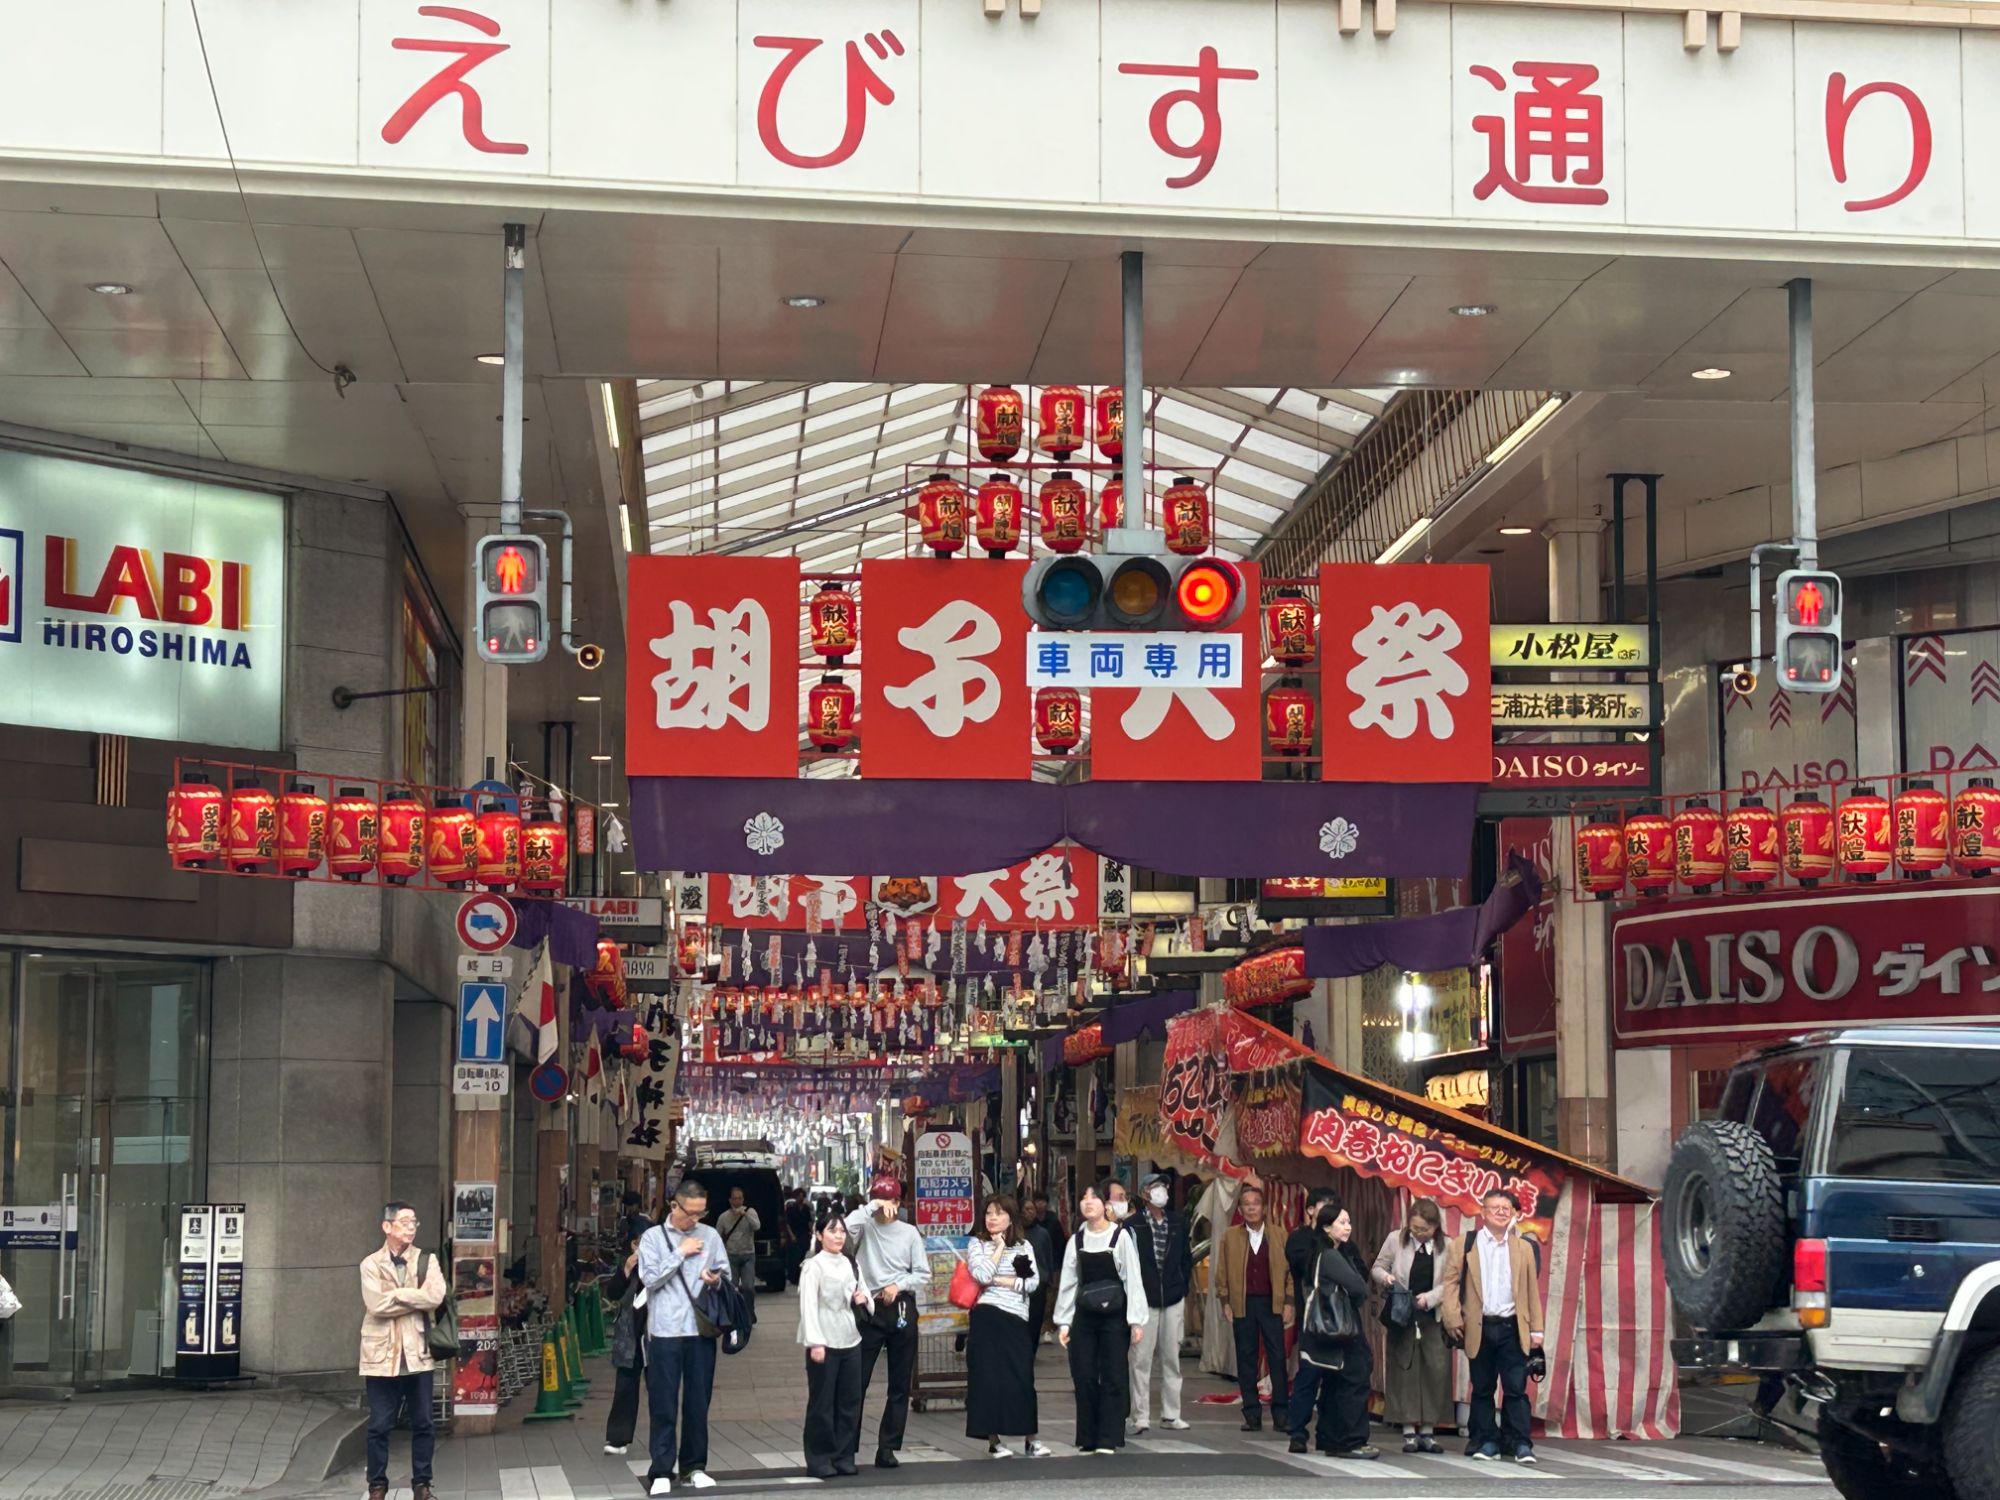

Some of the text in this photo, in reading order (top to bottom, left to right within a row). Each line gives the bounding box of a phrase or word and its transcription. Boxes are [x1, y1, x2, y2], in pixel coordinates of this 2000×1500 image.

[380, 5, 1932, 212] えびす通り
[45, 535, 252, 631] LABI
[44, 617, 252, 669] HIROSHIMA
[1037, 640, 1232, 680] 車両専用
[1509, 632, 1619, 660] 小松屋
[1491, 693, 1627, 719] 三浦法律事務所
[1592, 761, 1645, 776] ダイソー
[1742, 759, 1848, 796] DAISO
[1623, 925, 1860, 1011] DAISO
